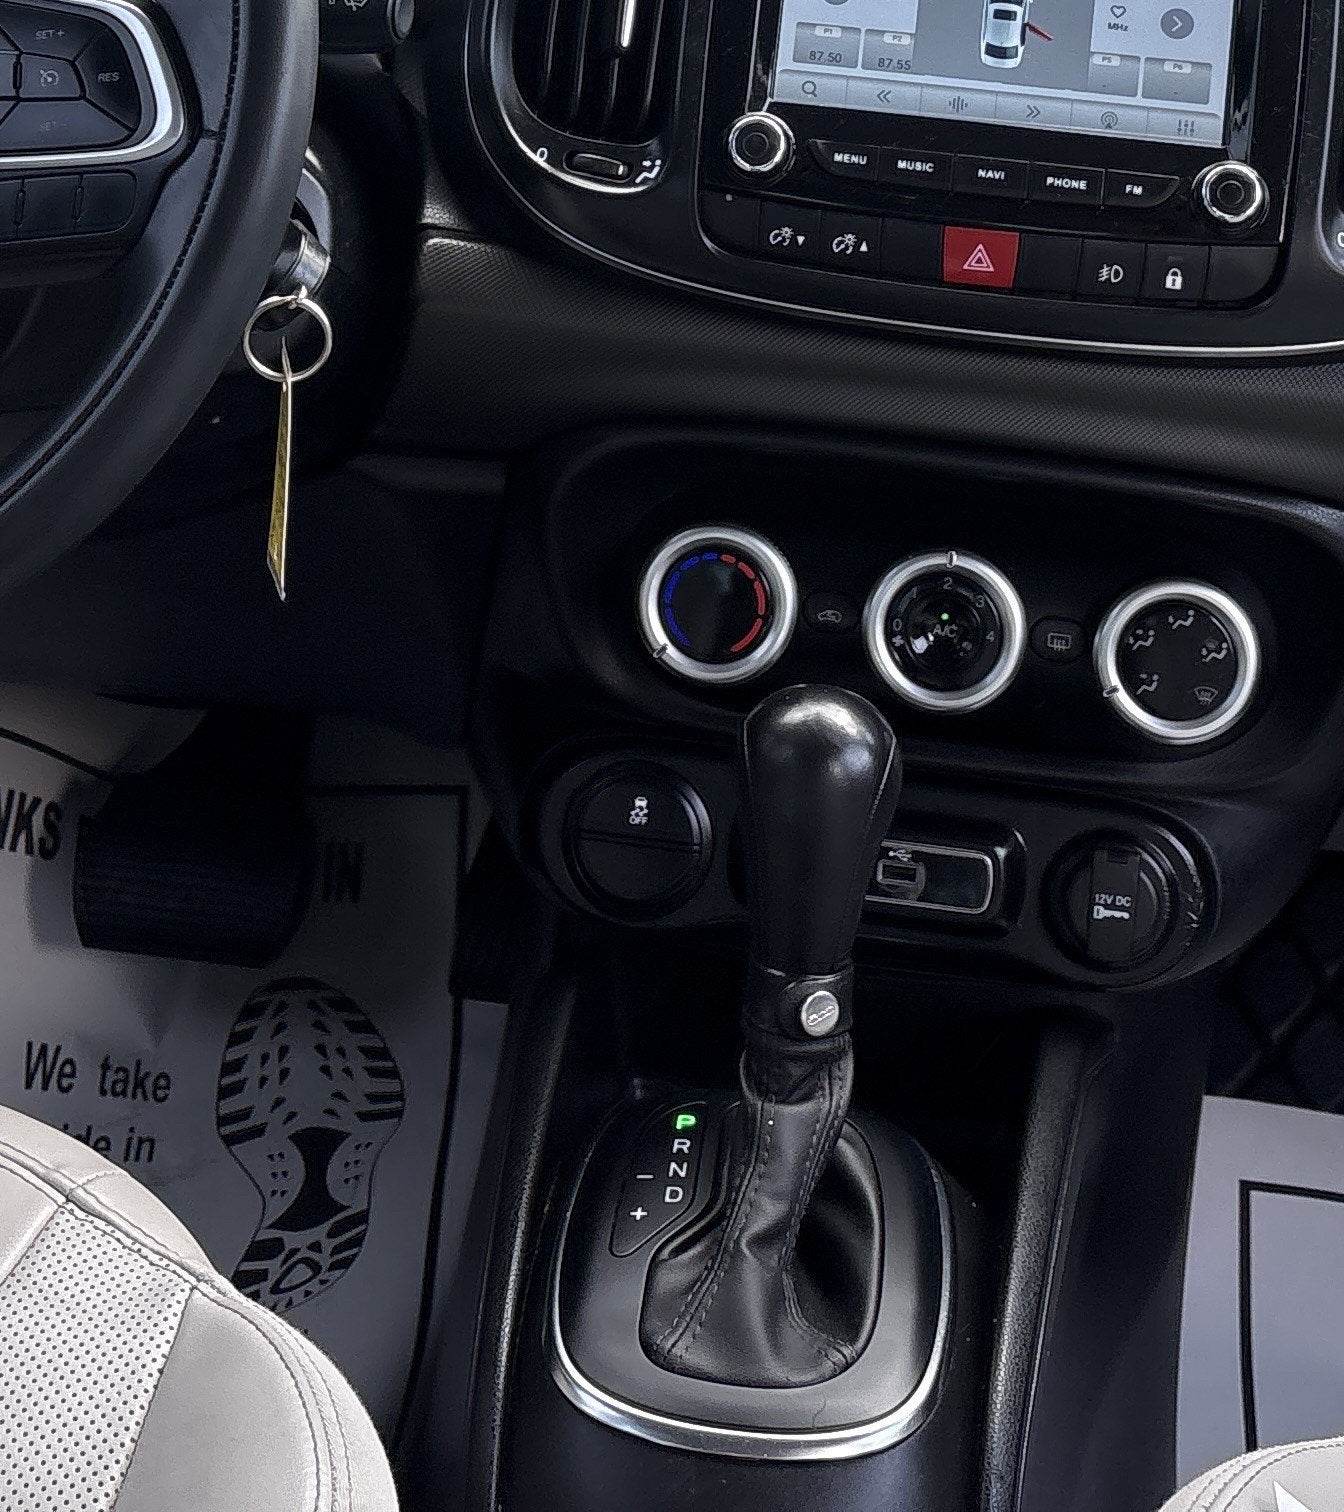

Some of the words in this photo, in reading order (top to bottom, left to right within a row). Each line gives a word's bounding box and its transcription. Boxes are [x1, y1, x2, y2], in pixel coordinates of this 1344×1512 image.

[1107, 21, 1129, 32] MHz
[35, 29, 55, 40] SET
[809, 50, 843, 64] 87.50
[877, 57, 911, 71] 87.55
[97, 72, 120, 83] RES
[833, 152, 868, 165] MENU
[896, 159, 935, 173] MUSIC
[977, 168, 1005, 180] NAVI
[1046, 176, 1087, 190] PHONE
[1125, 184, 1143, 196] FM
[942, 576, 953, 590] 2
[975, 594, 985, 608] 3
[892, 618, 903, 631] 0
[932, 623, 958, 638] A/C
[985, 630, 995, 643] 4
[628, 816, 648, 825] OFF
[1094, 893, 1114, 905] 12V
[1115, 895, 1132, 908] DC
[23, 1040, 78, 1094] We
[97, 1054, 172, 1104] take
[675, 1113, 697, 1130] P
[122, 1125, 156, 1163] in
[672, 1138, 691, 1155] R
[668, 1161, 688, 1178] N
[664, 1186, 683, 1203] D
